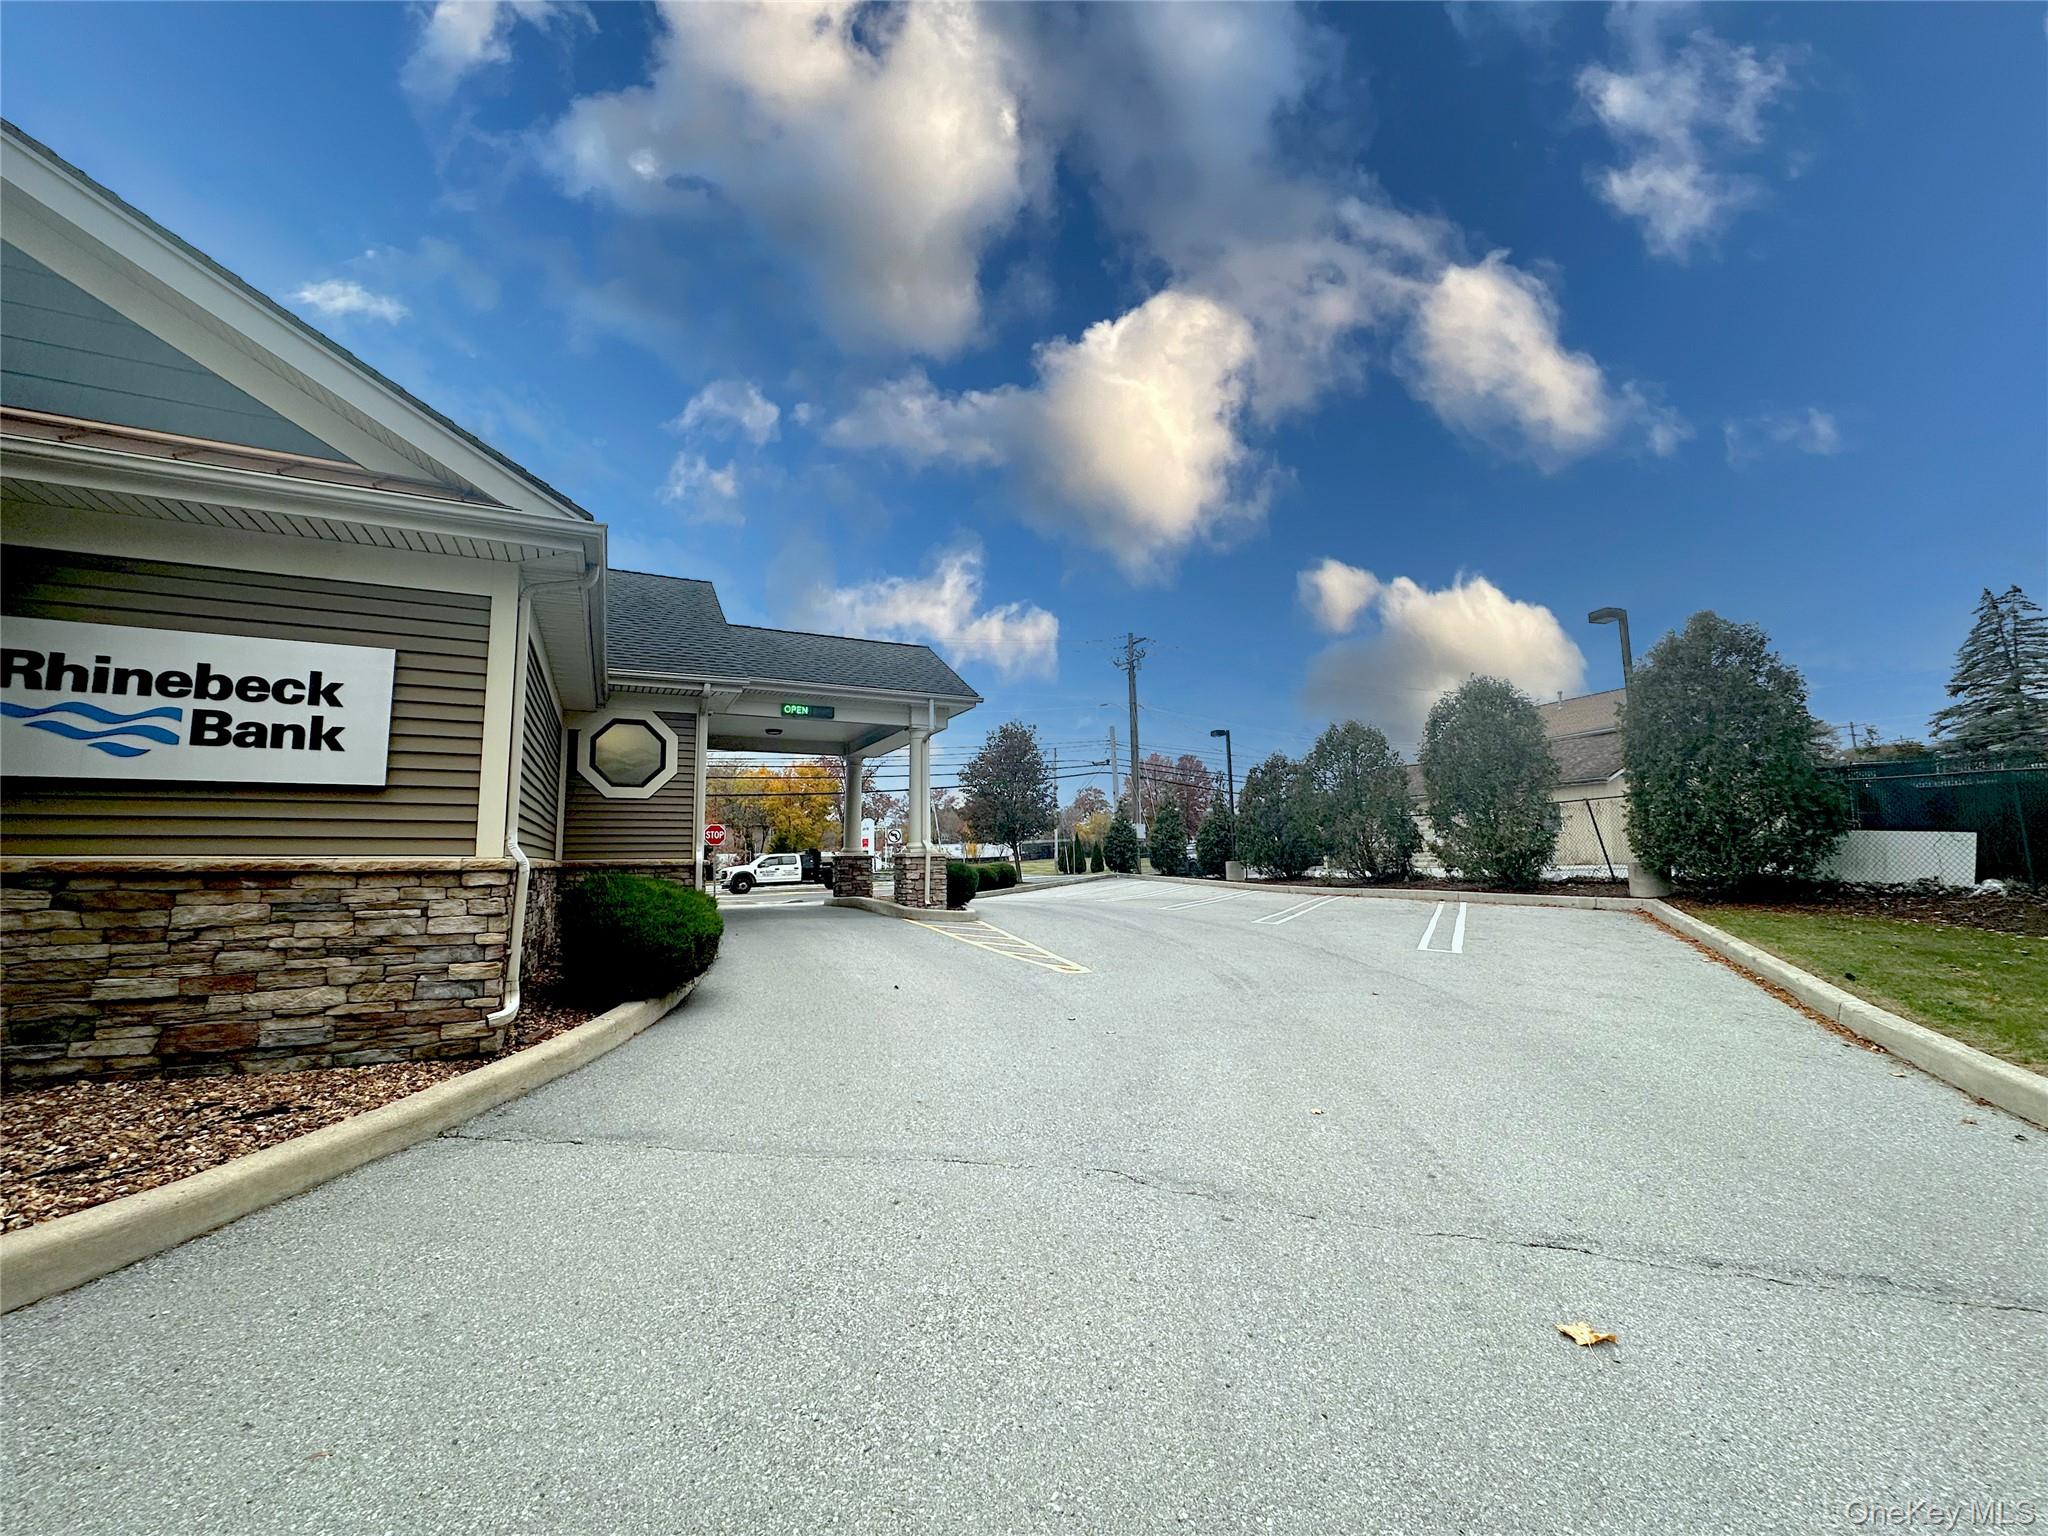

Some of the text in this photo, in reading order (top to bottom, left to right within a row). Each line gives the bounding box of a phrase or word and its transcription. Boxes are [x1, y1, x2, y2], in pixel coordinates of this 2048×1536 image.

[0, 648, 344, 708] Rhinebeck
[784, 705, 809, 715] OPEN
[189, 708, 346, 752] Bank
[705, 830, 724, 839] STOP
